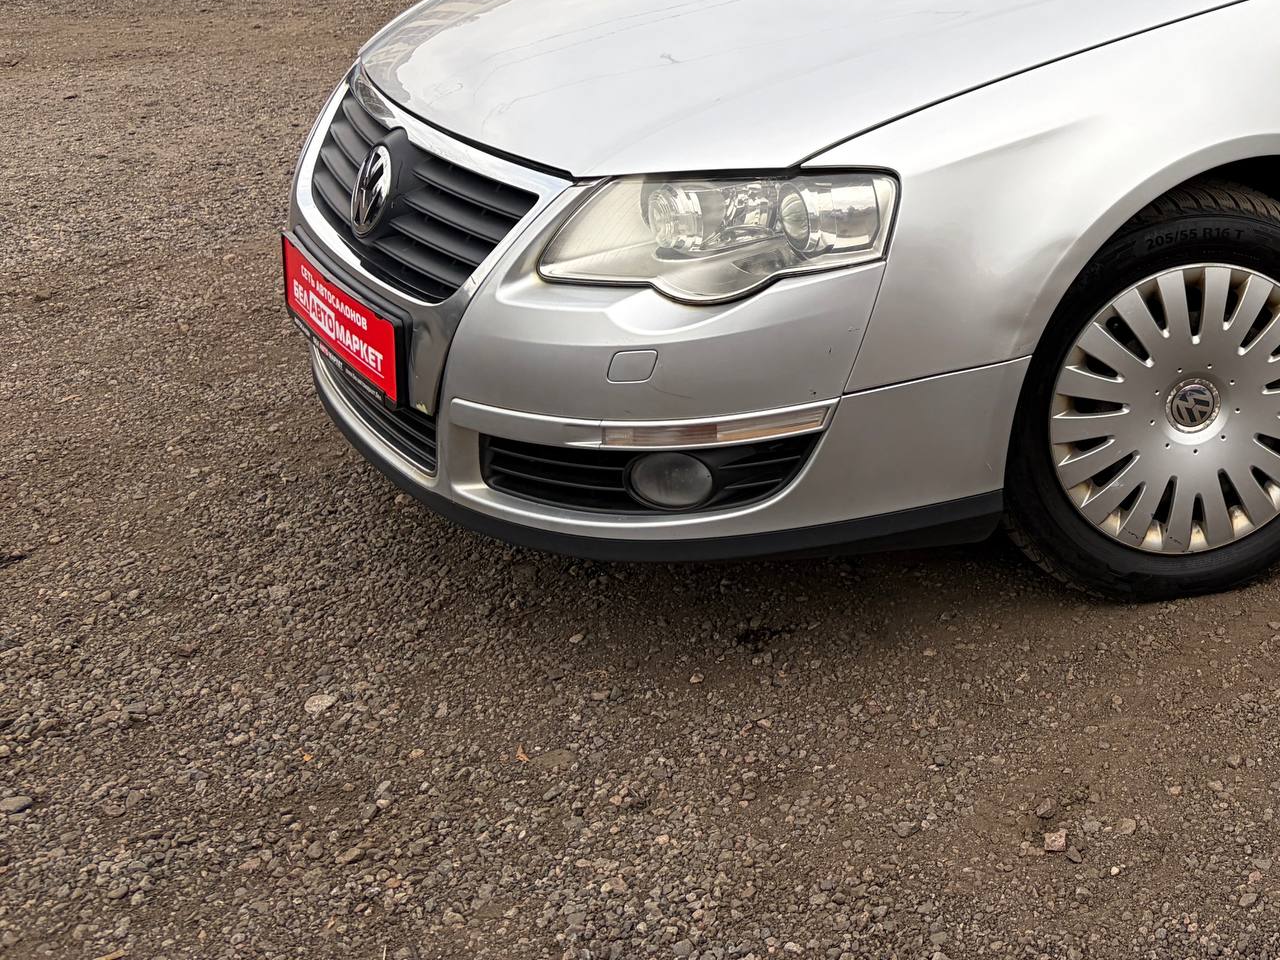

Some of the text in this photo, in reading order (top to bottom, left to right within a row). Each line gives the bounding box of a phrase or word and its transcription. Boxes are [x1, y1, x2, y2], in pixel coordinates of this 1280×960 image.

[1146, 228, 1197, 251] 205/55
[1203, 227, 1231, 240] R16
[293, 278, 310, 311] БЕЛ
[310, 298, 335, 337] АВТО
[335, 320, 384, 373] МАРКЕТ
[300, 265, 316, 287] СЕТЬ
[315, 280, 368, 331] АВТОСАЛОНОВ
